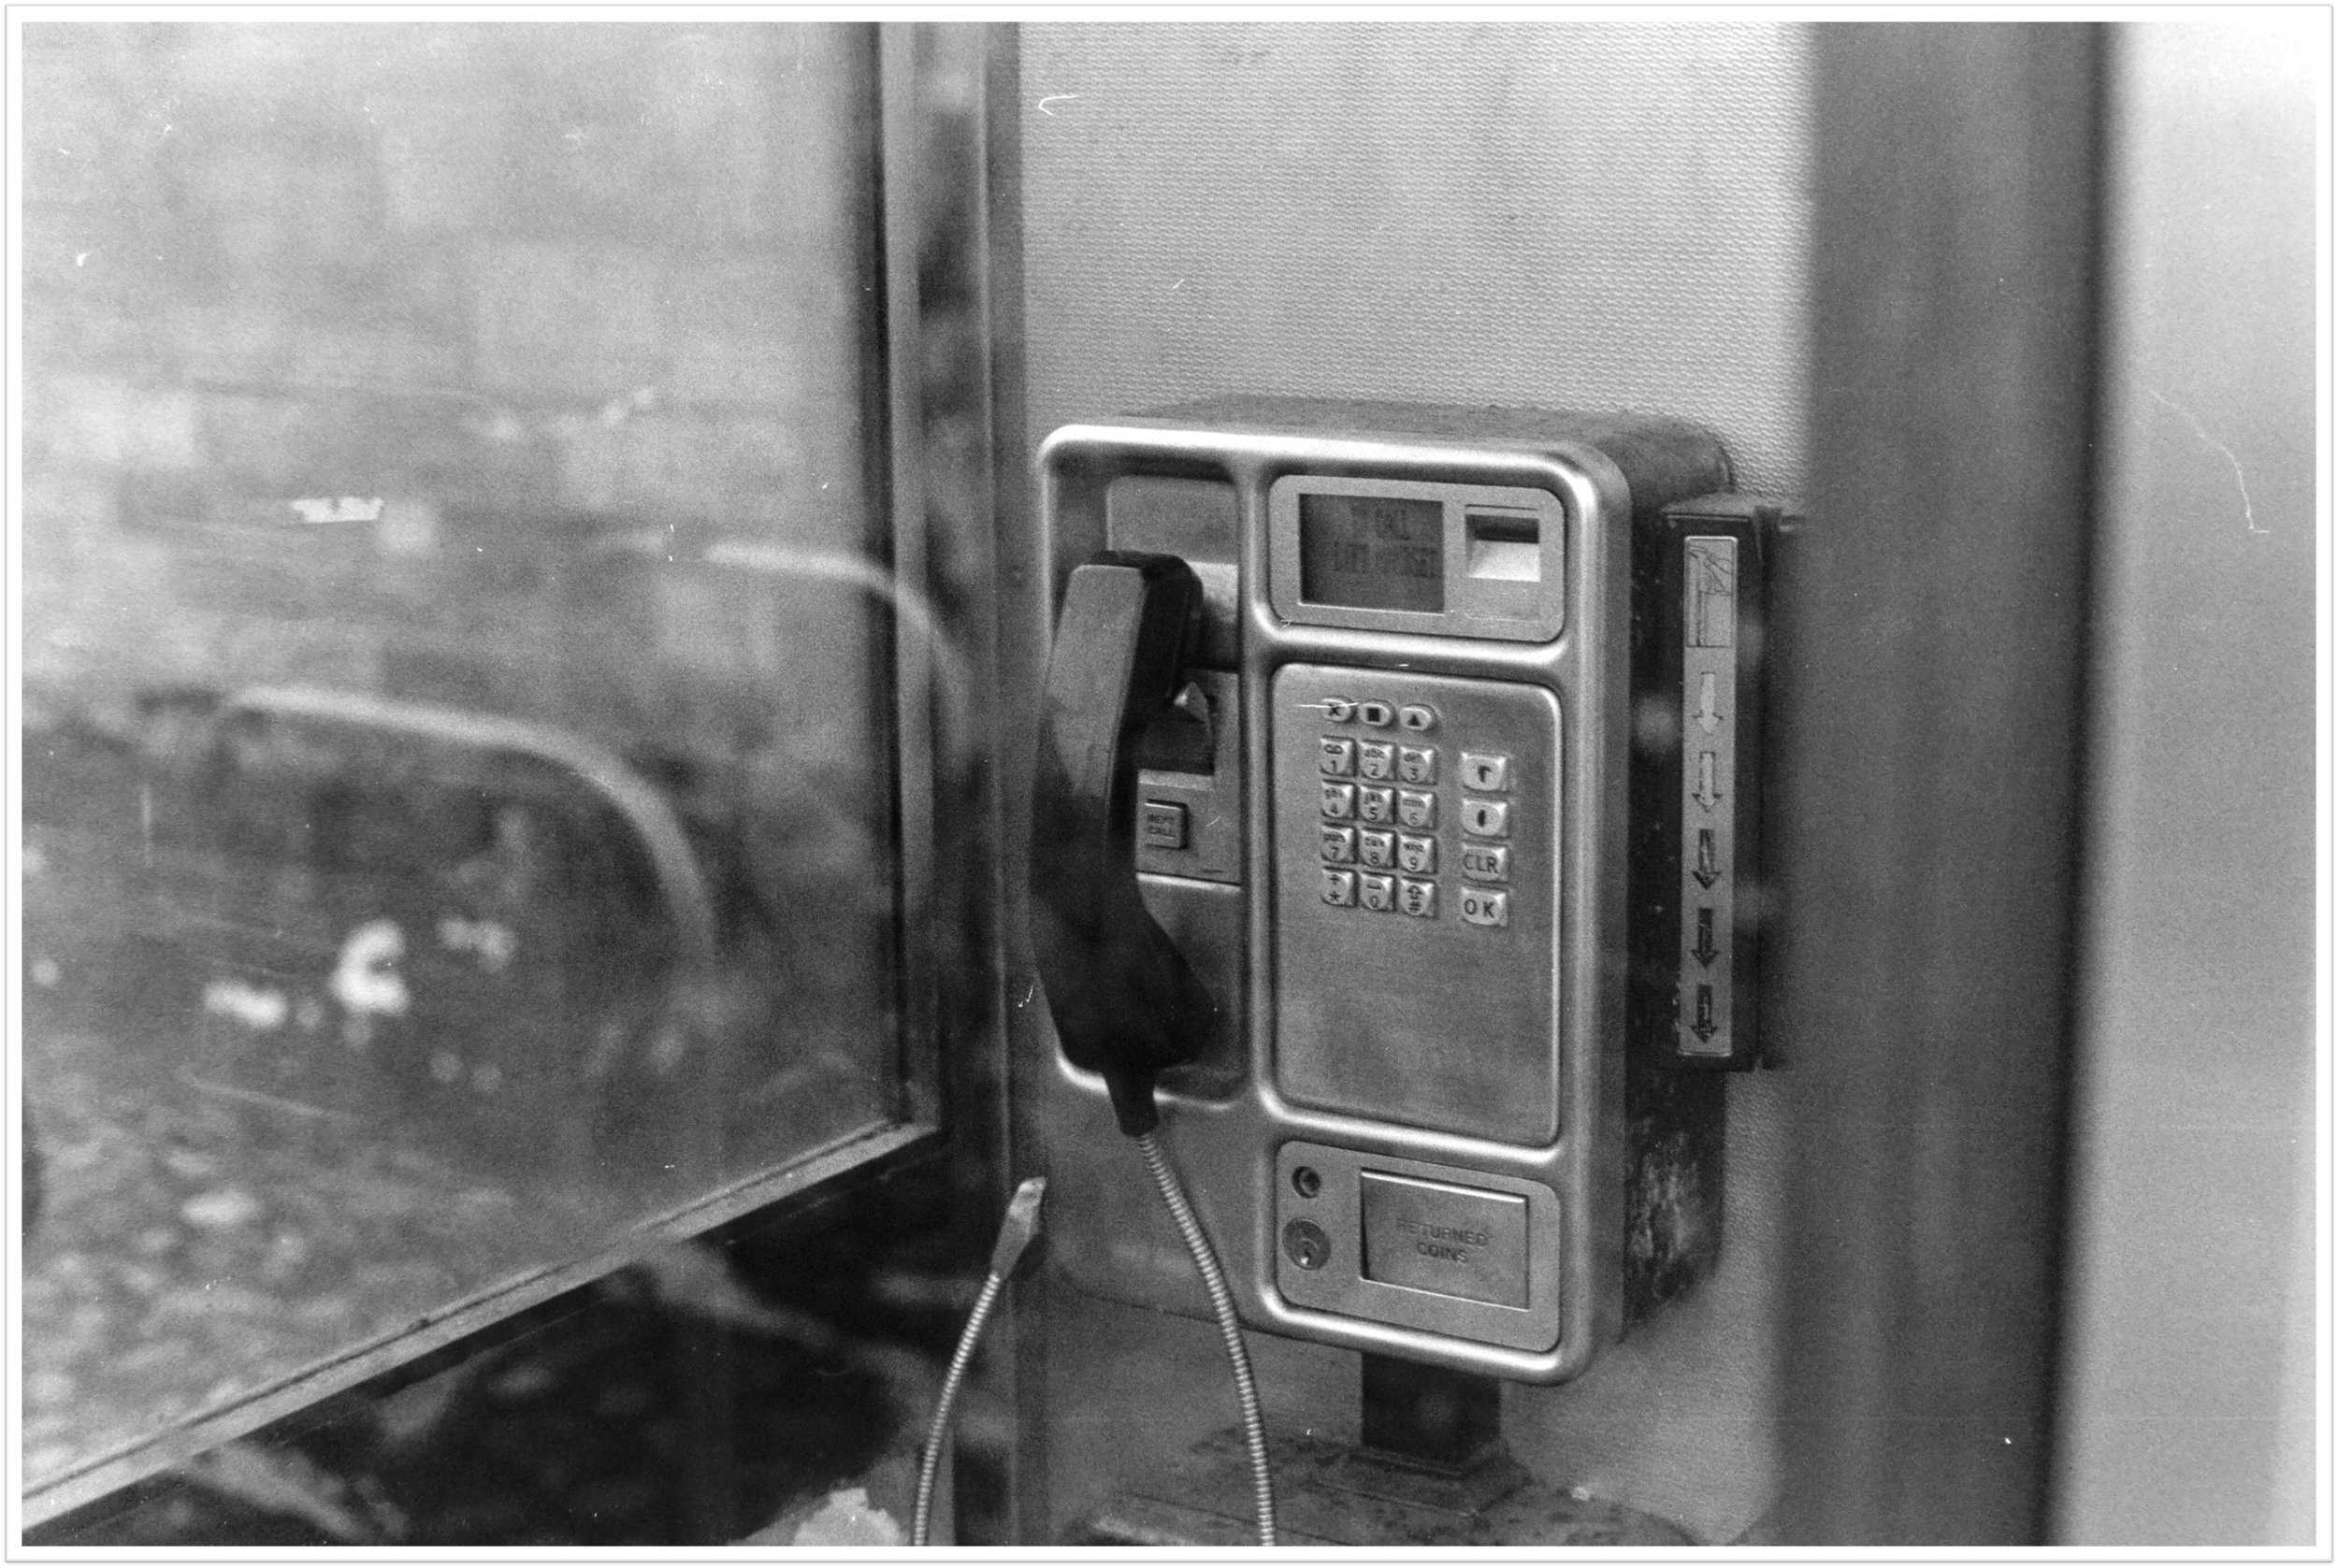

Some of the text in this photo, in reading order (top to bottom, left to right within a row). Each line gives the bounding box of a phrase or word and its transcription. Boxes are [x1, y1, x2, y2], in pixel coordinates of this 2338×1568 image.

[1330, 759, 1338, 774] 1
[1368, 763, 1379, 777] 2
[1409, 767, 1420, 782] 3
[1368, 805, 1379, 821] 5
[1331, 845, 1340, 859] 7
[1369, 851, 1379, 864] 8
[1408, 856, 1419, 870] 9
[1463, 854, 1499, 874] CLR
[1368, 894, 1379, 909] 0
[1464, 899, 1495, 919] OK
[1397, 1218, 1489, 1246] RETURNED
[1418, 1242, 1468, 1264] COINS
